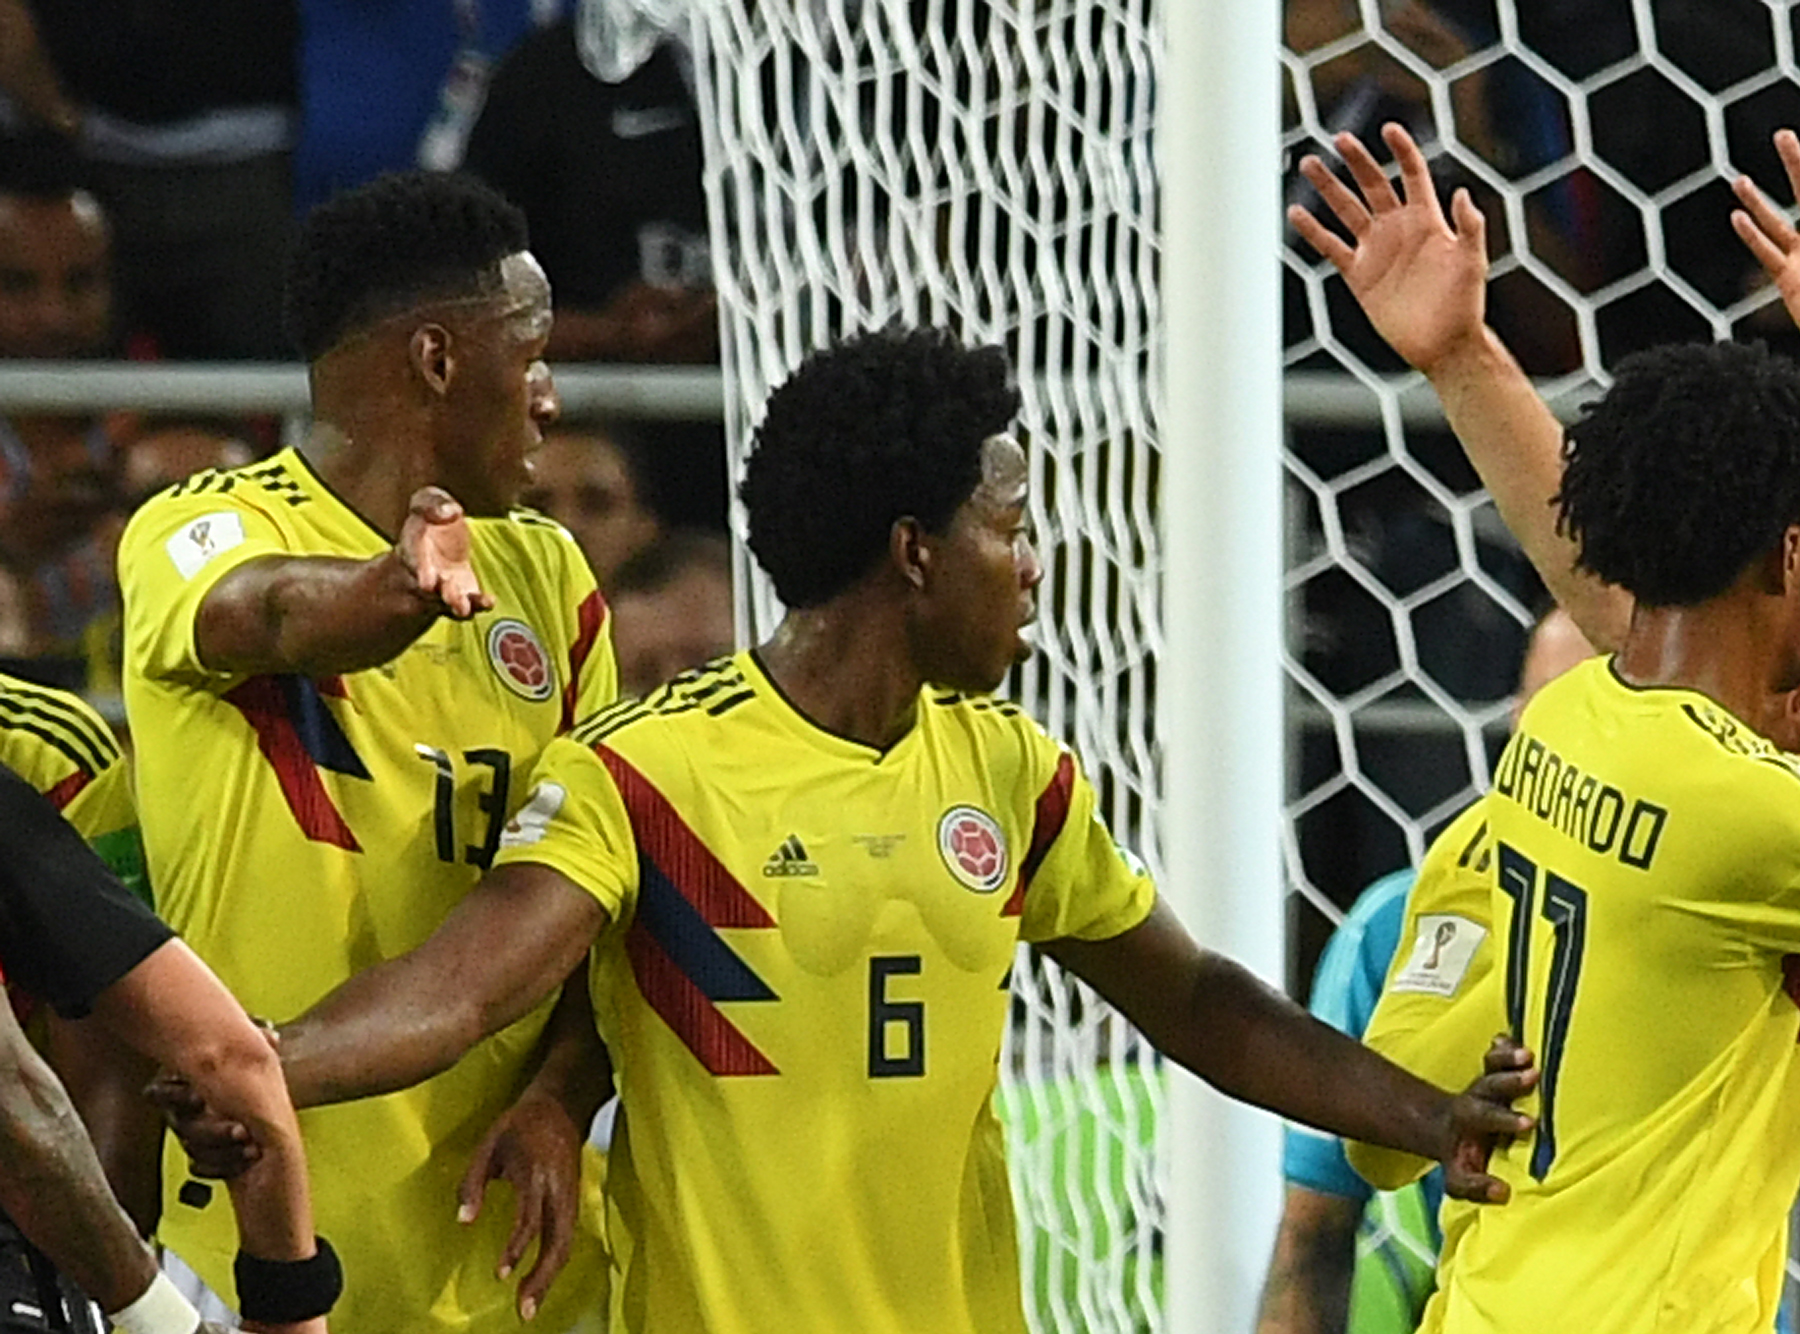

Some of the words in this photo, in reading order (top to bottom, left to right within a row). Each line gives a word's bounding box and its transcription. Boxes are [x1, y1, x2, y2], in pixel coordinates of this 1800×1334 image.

[415, 744, 511, 870] 13
[868, 955, 926, 1079] 6
[1497, 839, 1589, 1184] 11
